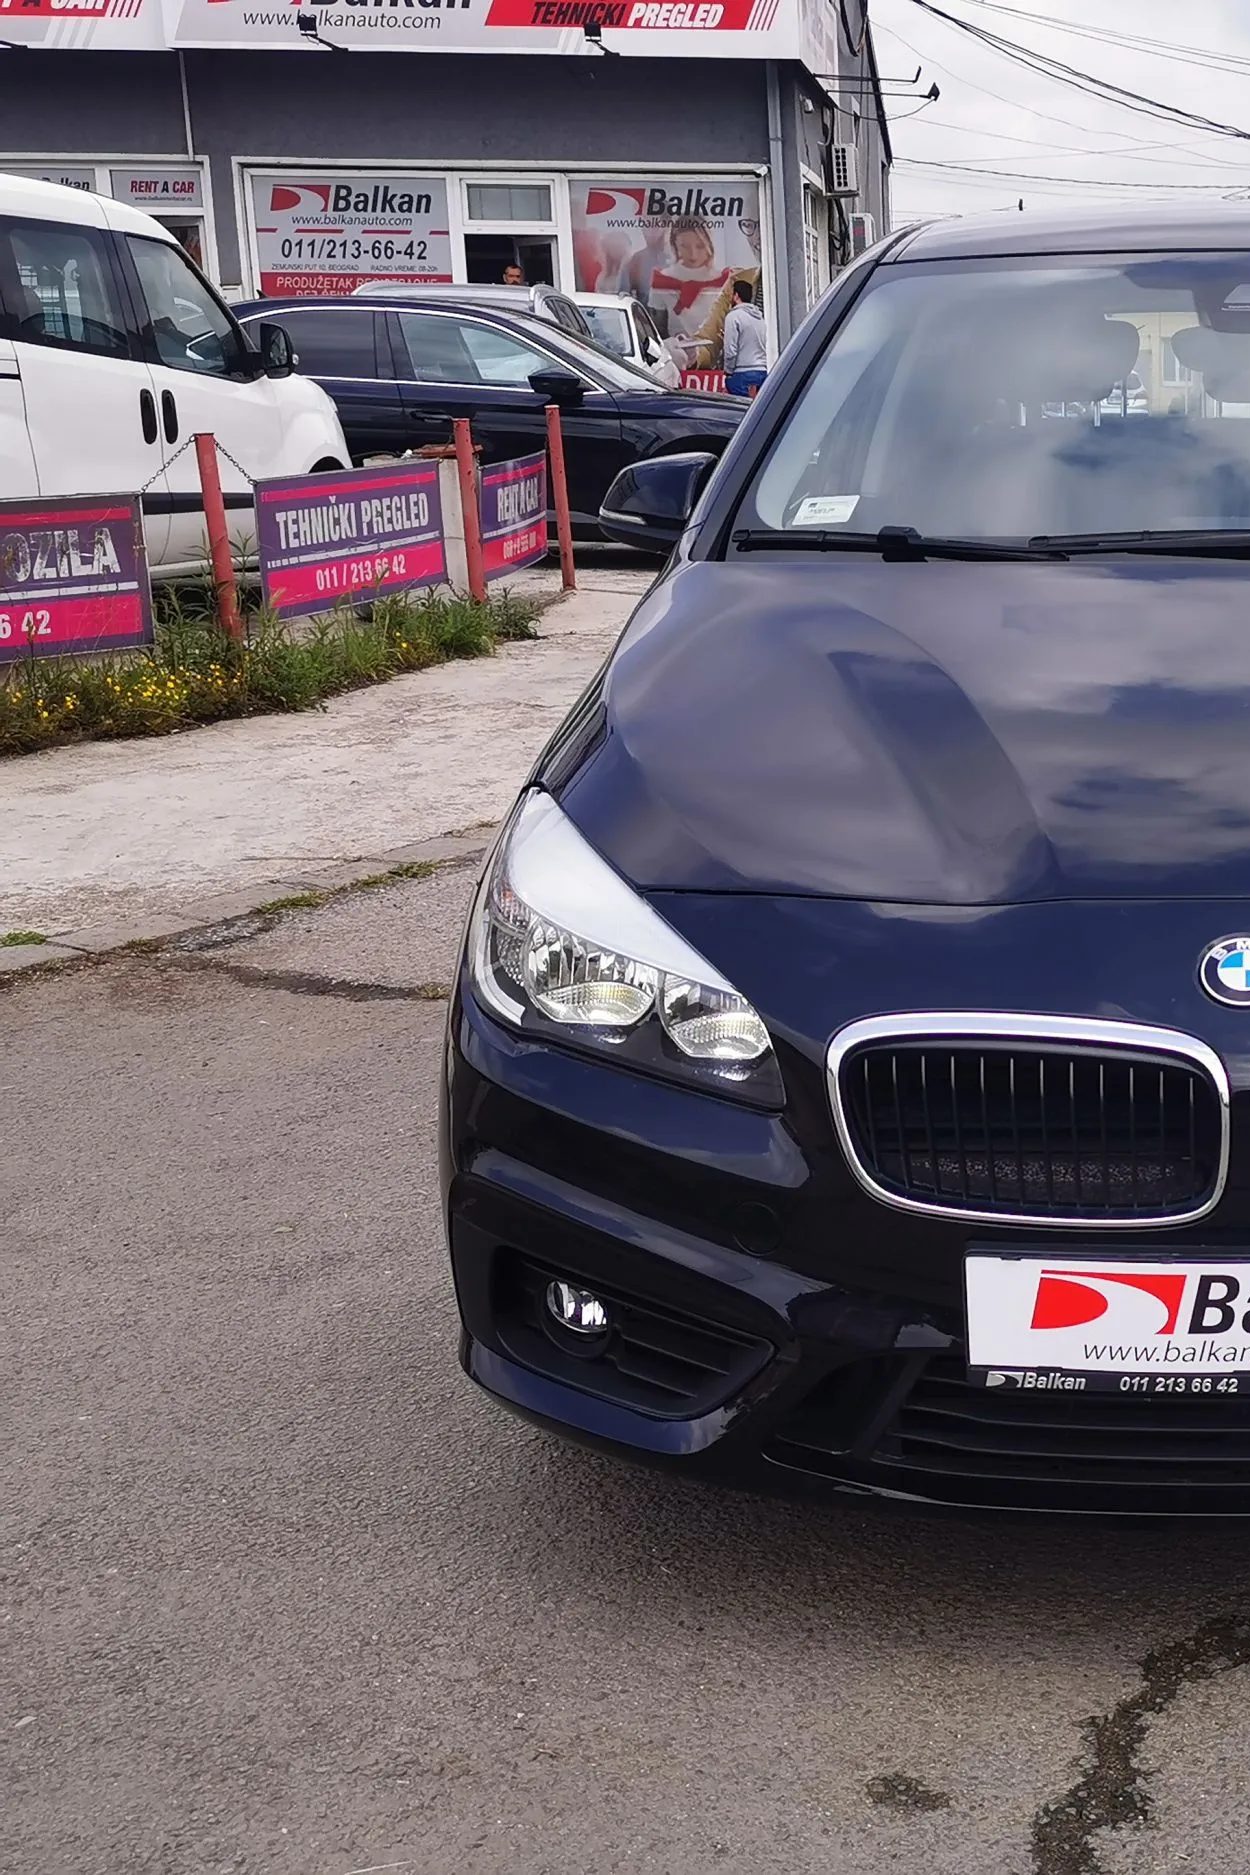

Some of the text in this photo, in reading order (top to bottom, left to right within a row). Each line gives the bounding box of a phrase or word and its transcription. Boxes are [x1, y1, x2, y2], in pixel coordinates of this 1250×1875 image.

[626, 2, 724, 28] PREGLED
[130, 180, 195, 193] RENT A CAR
[332, 184, 432, 214] Balkan
[646, 188, 744, 217] Balkan
[292, 214, 412, 226] www.balkanauto.com
[606, 217, 724, 229] www.balkanauto.com
[281, 238, 428, 260] 011/213-66-42
[276, 275, 353, 289] PRODUŽETAK
[275, 492, 429, 550] TEHNIČKI PREGLED
[316, 566, 339, 590] 011
[350, 560, 373, 584] 213
[392, 553, 406, 575] 42
[21, 609, 51, 636] 42
[1023, 1372, 1086, 1390] Balkan
[1119, 1376, 1150, 1392] 011
[1155, 1377, 1186, 1392] 213
[1191, 1377, 1213, 1392] 66
[1216, 1378, 1239, 1393] 42
